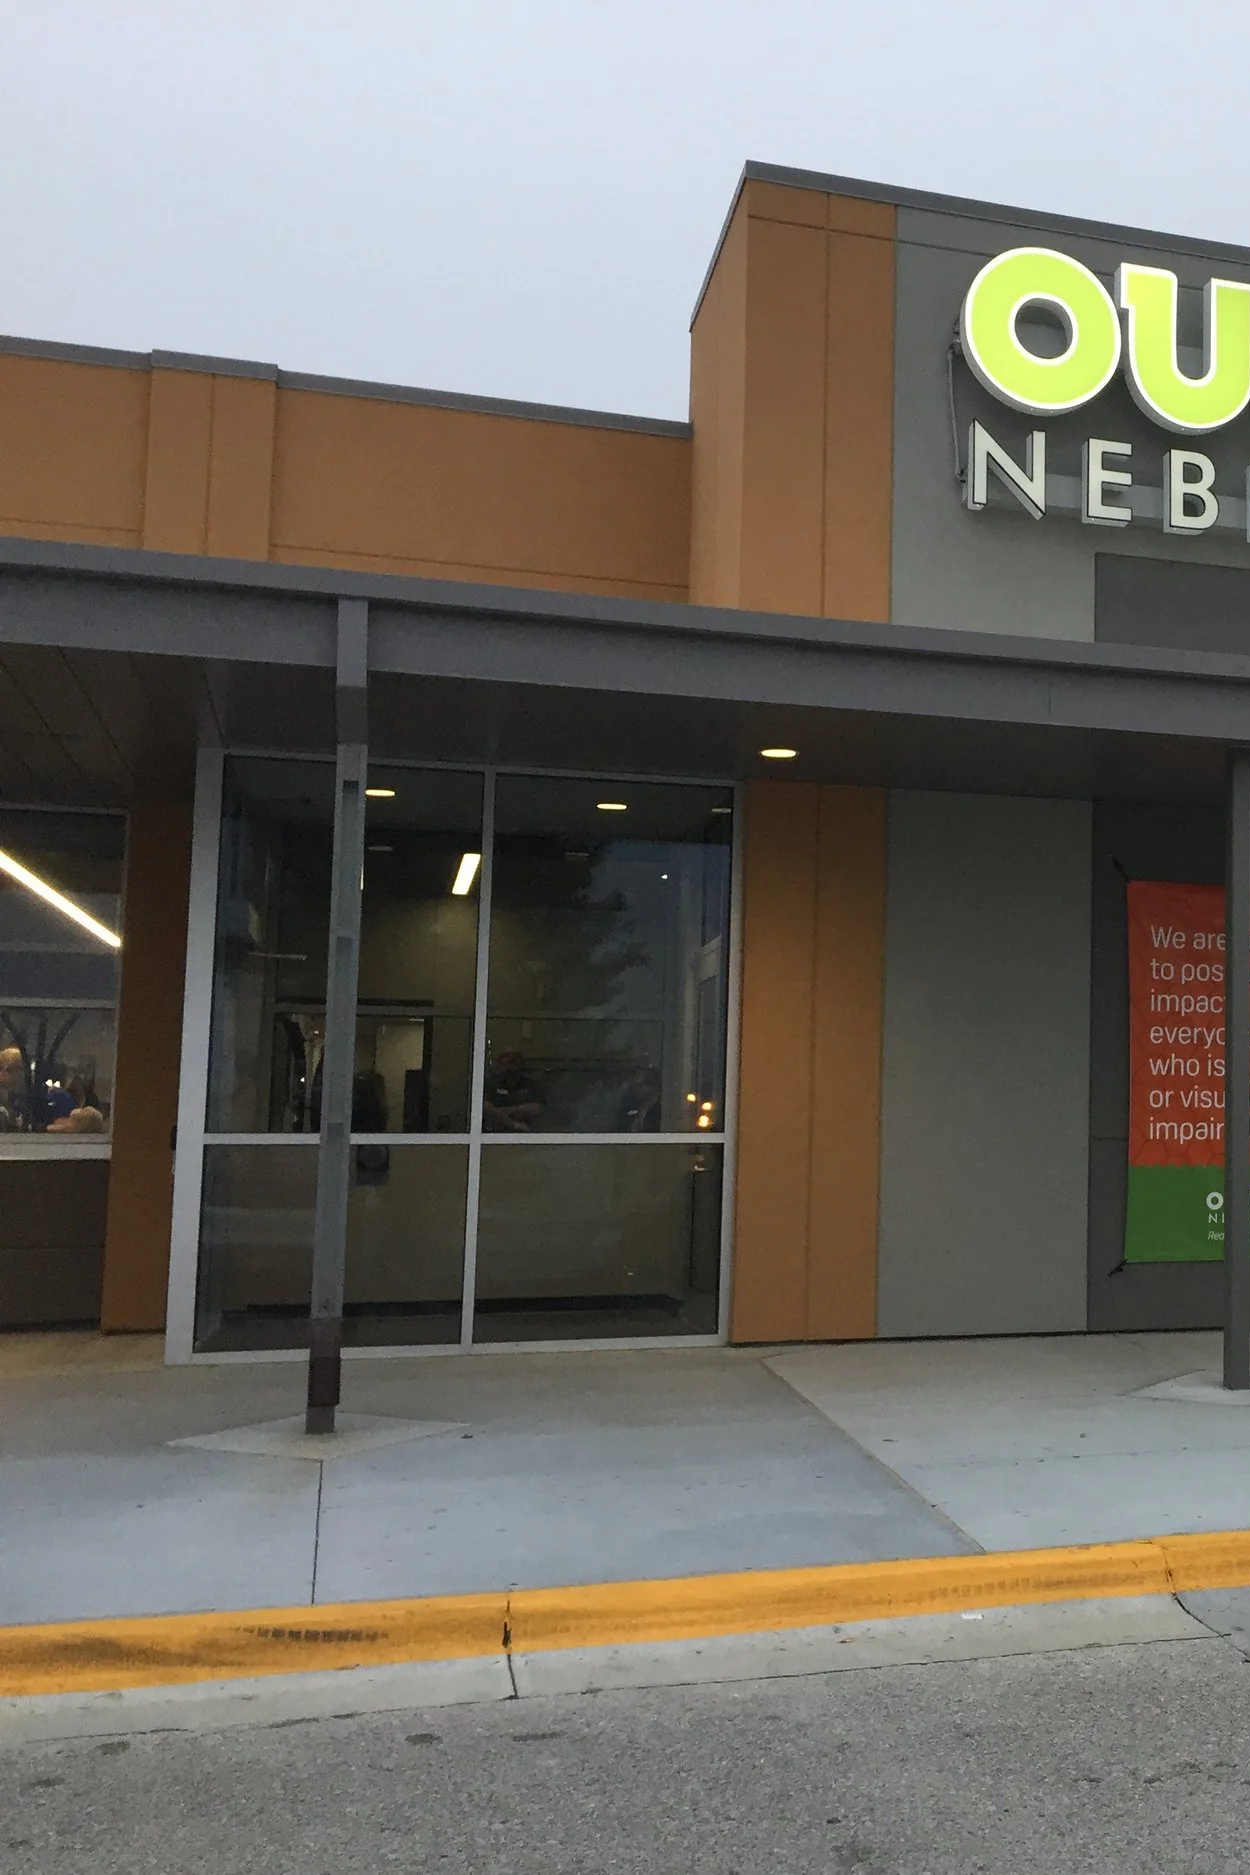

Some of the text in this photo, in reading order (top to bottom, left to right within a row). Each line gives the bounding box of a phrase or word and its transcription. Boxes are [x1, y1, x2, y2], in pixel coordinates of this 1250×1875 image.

[1150, 925, 1186, 950] We
[1193, 932, 1226, 951] are
[1150, 957, 1174, 981] to
[1150, 988, 1226, 1017] impac
[1149, 1053, 1200, 1077] who
[1207, 1054, 1226, 1077] is
[1149, 1089, 1174, 1108] or
